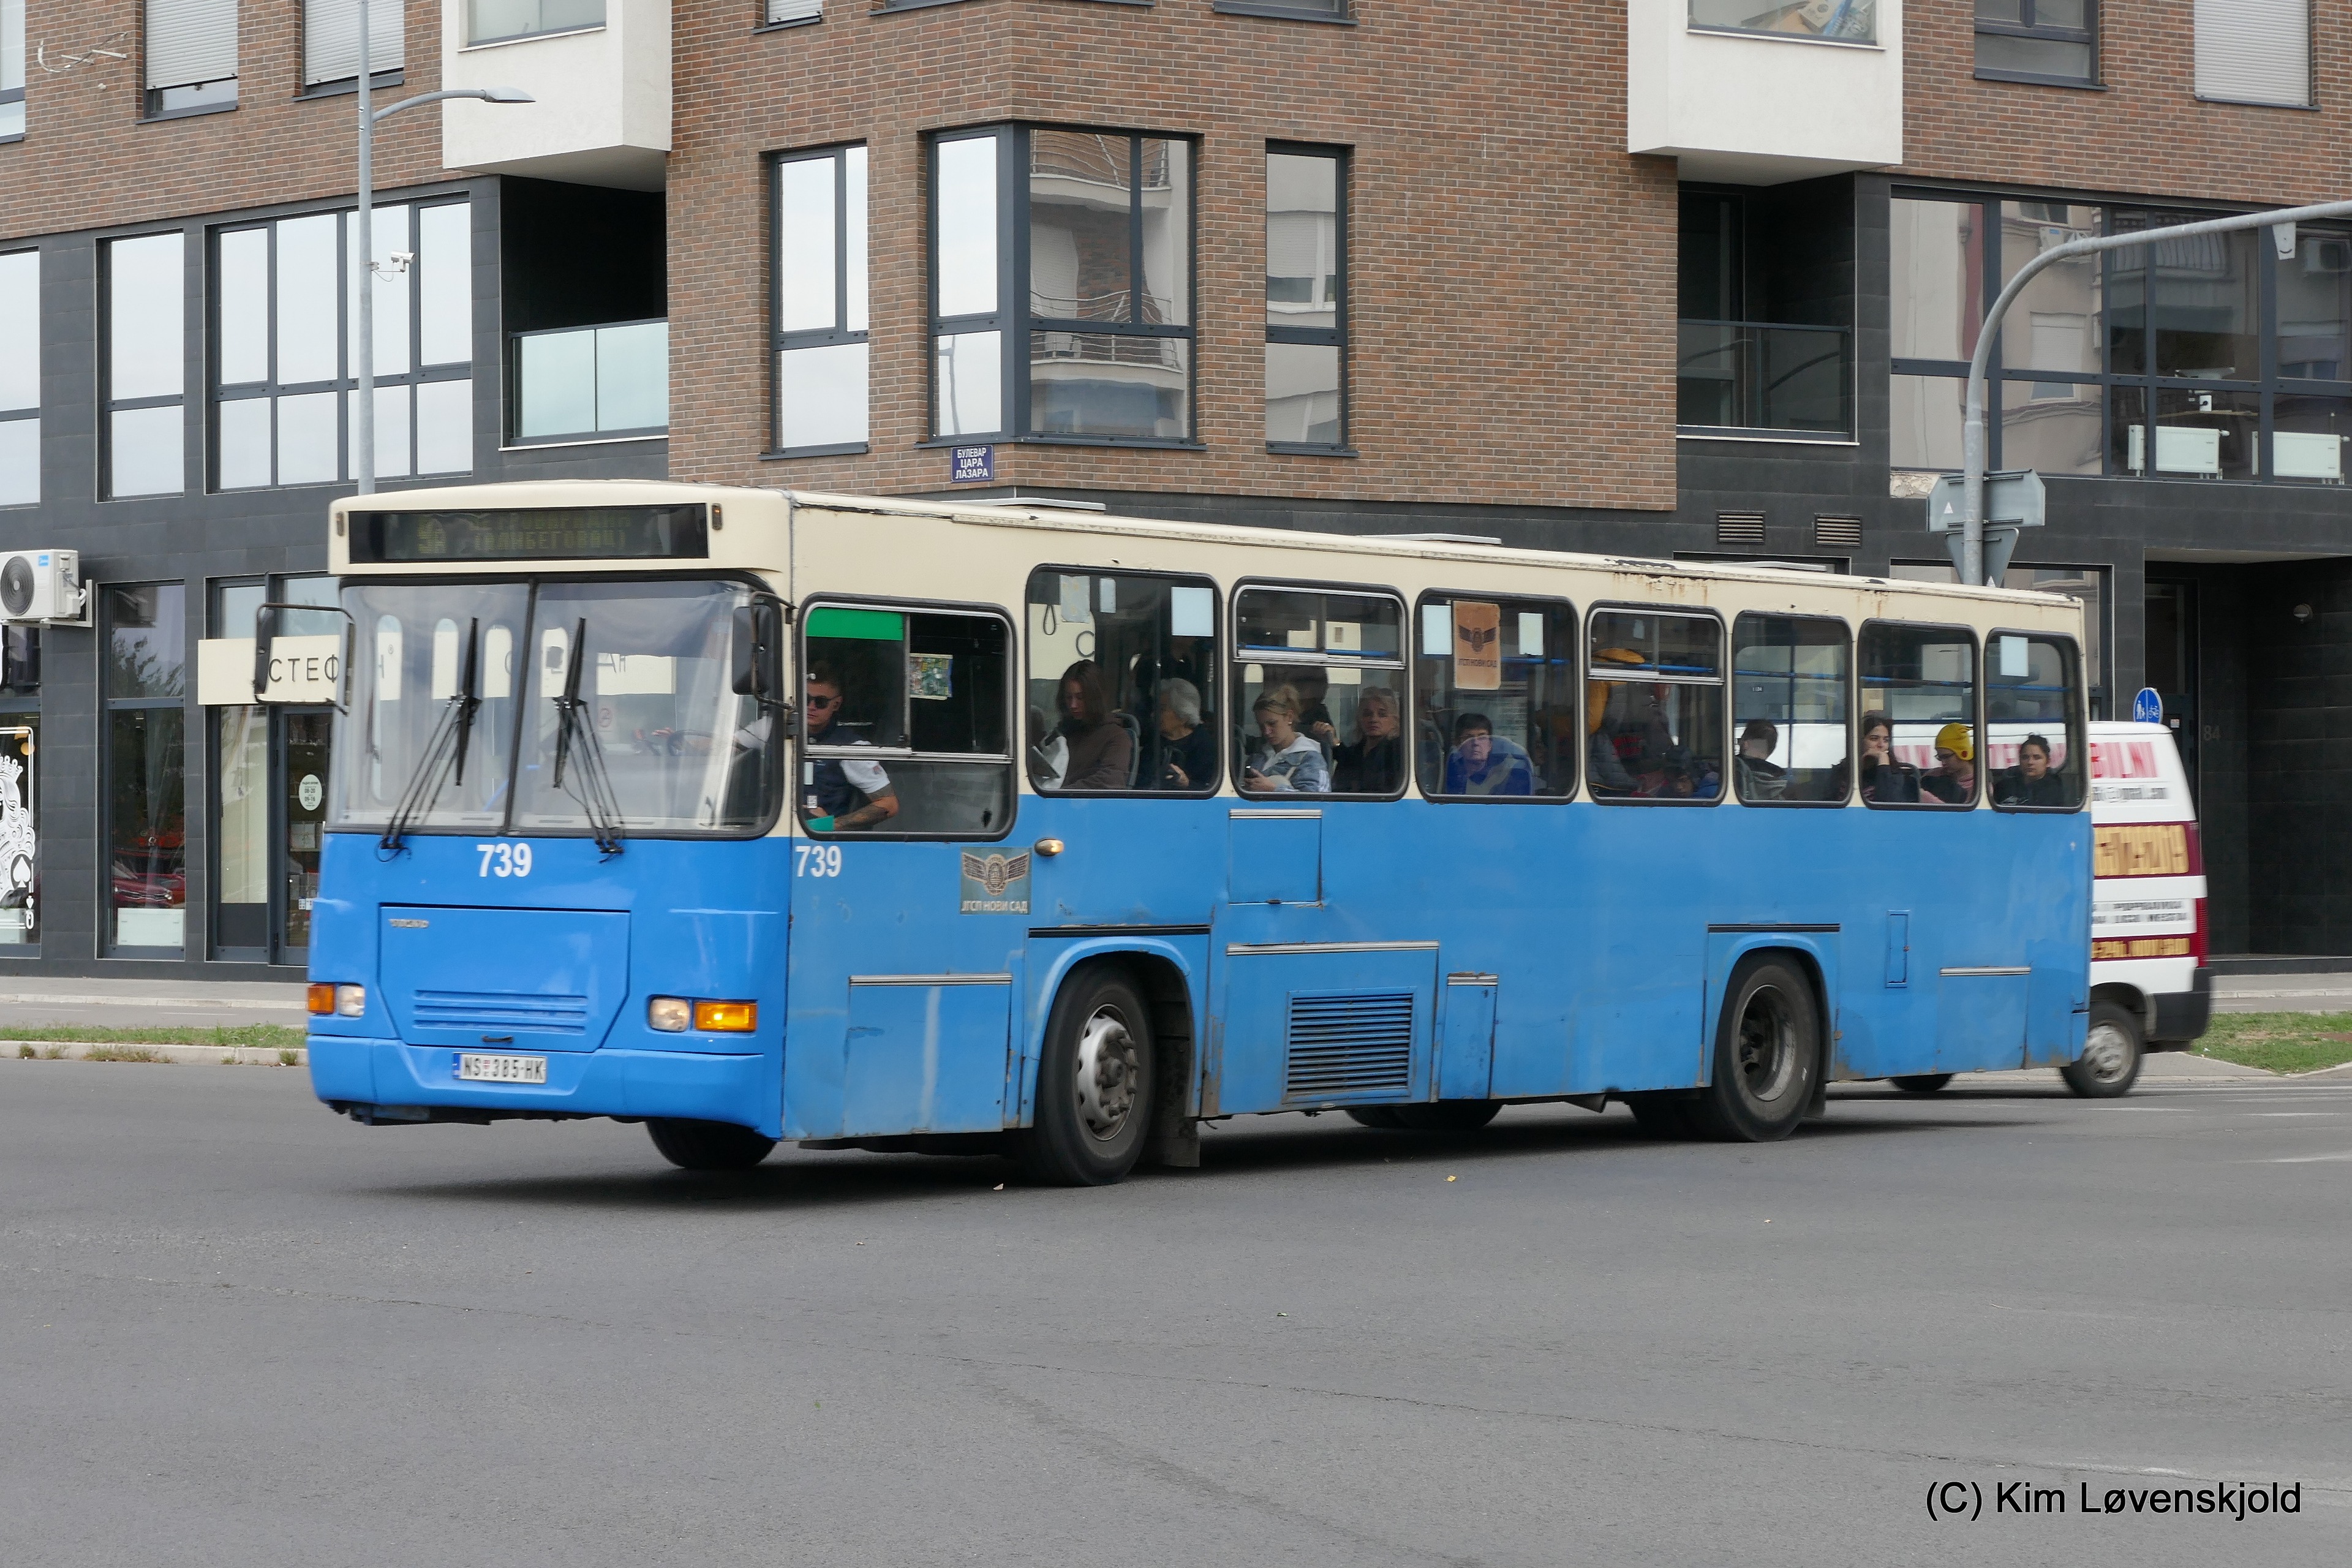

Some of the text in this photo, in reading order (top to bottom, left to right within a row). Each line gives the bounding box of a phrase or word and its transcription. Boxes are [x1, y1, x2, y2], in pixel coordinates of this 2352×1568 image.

[957, 448, 987, 458] БУЛЕВАР
[960, 458, 983, 470] ЦАРА
[955, 468, 989, 479] ЛАЗАРА
[477, 843, 532, 878] 739
[796, 845, 842, 878] 739
[982, 901, 1008, 911] НОВИ
[1009, 901, 1028, 913] САД
[464, 1057, 481, 1076] NS
